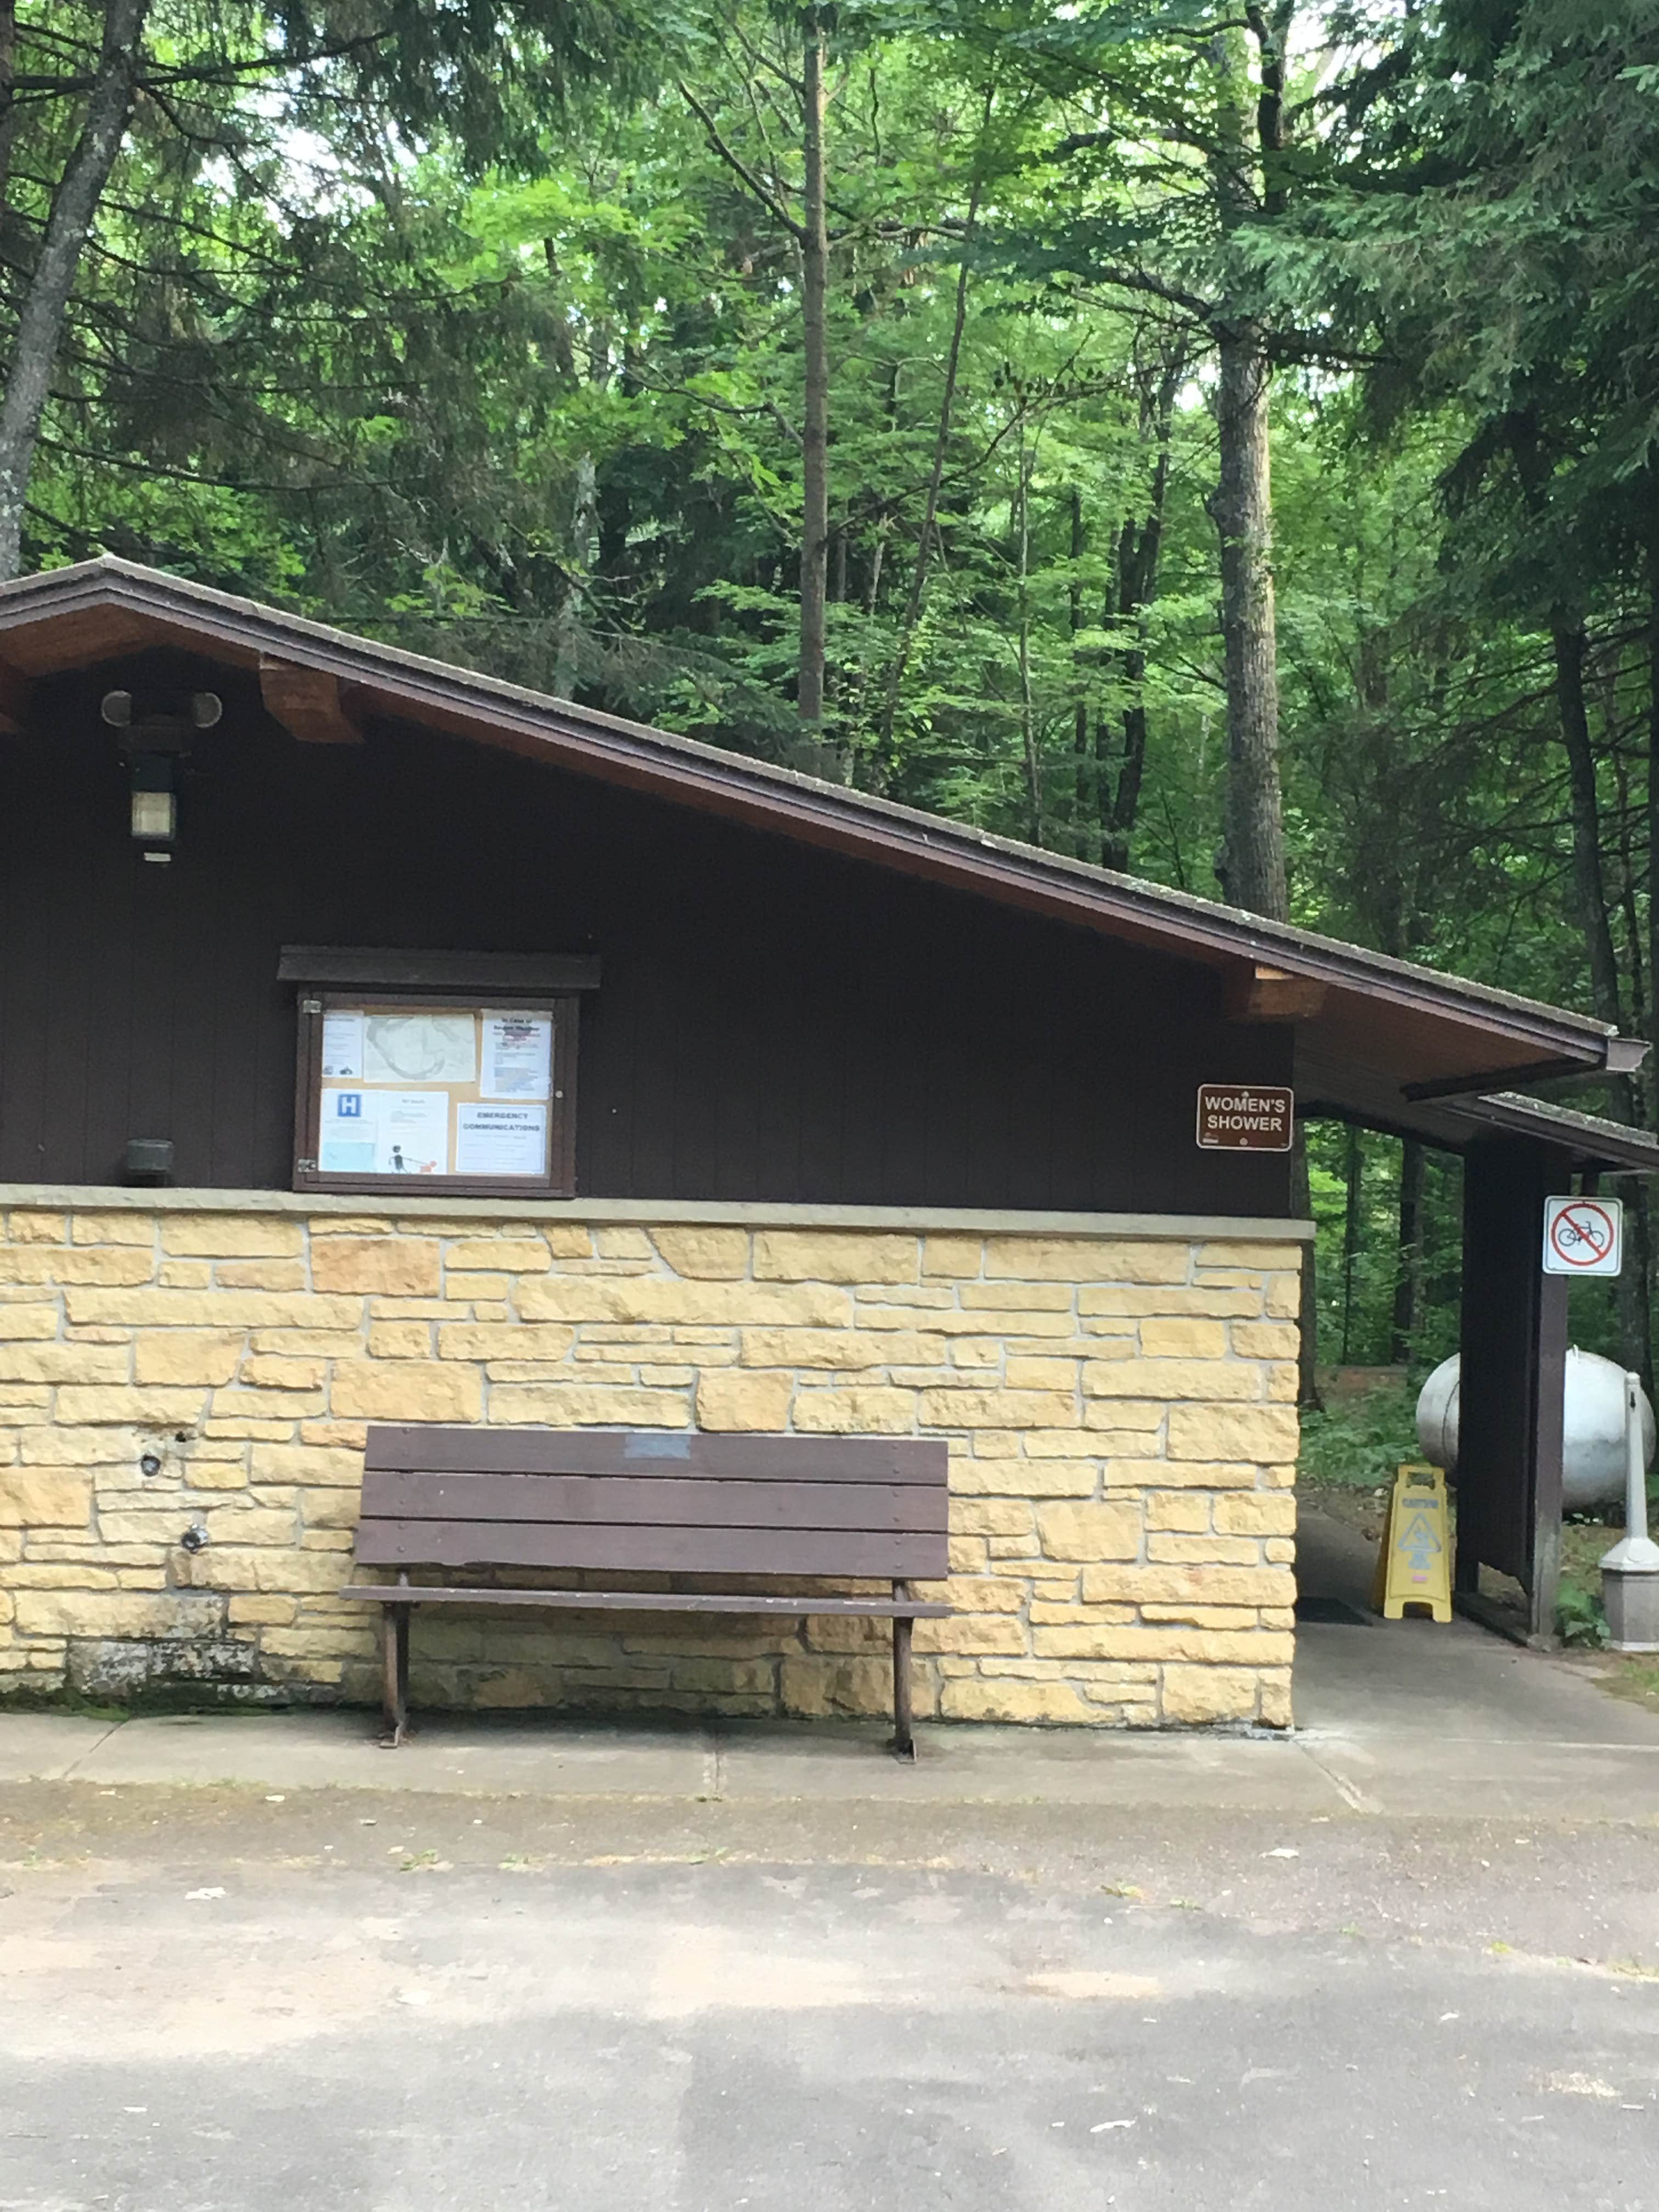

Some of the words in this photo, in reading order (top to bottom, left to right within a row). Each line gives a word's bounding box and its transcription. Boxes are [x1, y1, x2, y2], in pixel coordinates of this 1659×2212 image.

[1205, 1096, 1285, 1113] WOMEN'S
[462, 1123, 540, 1131] COMMUNICATIONS
[1207, 1114, 1283, 1132] SHOWER
